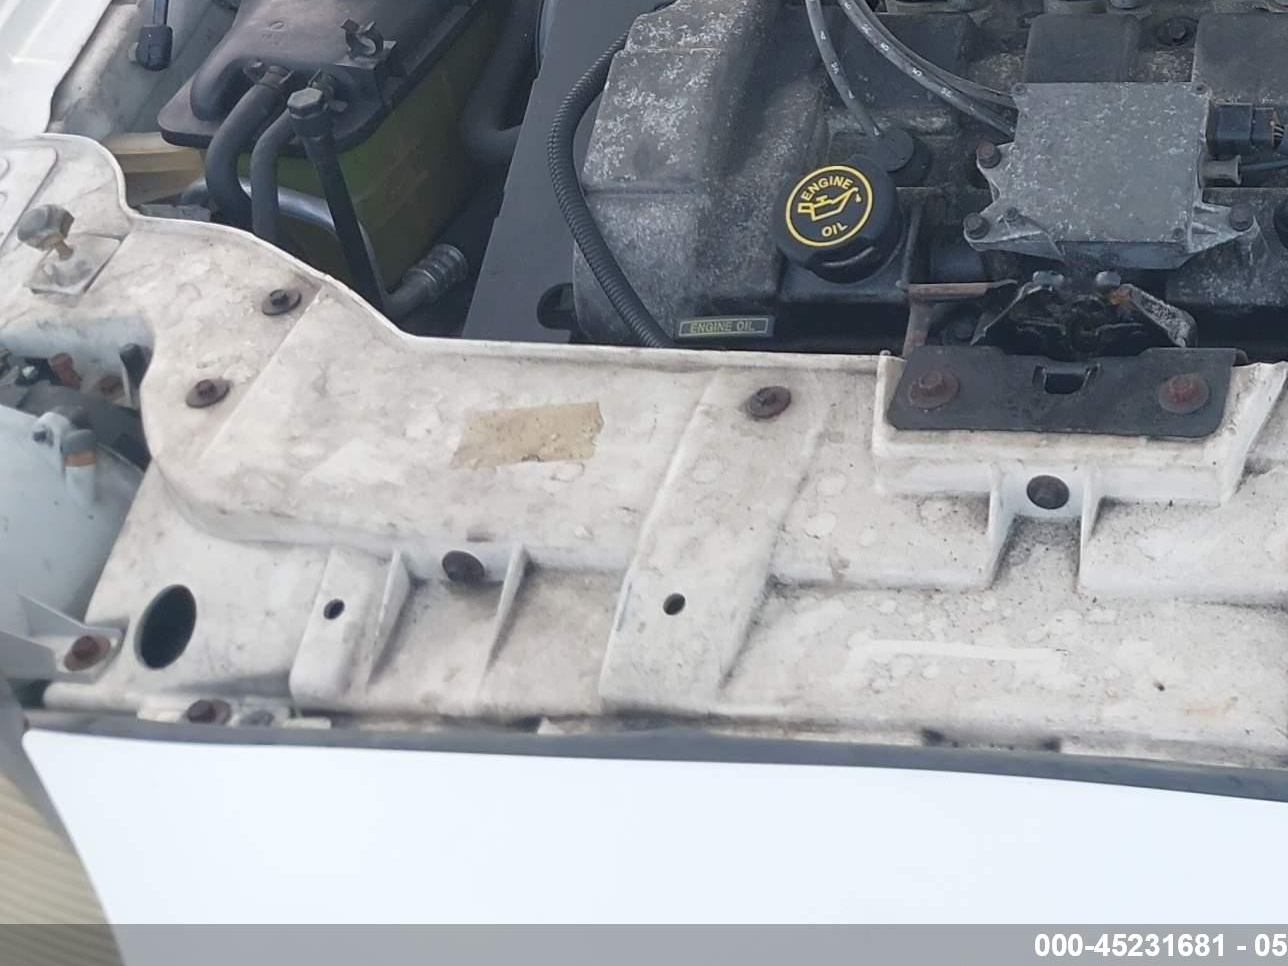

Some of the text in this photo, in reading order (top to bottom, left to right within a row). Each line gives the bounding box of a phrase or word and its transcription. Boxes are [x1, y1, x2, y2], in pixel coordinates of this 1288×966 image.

[800, 176, 853, 201] ENGINE
[821, 222, 848, 238] OIL
[690, 319, 755, 334] ENGINE OIL
